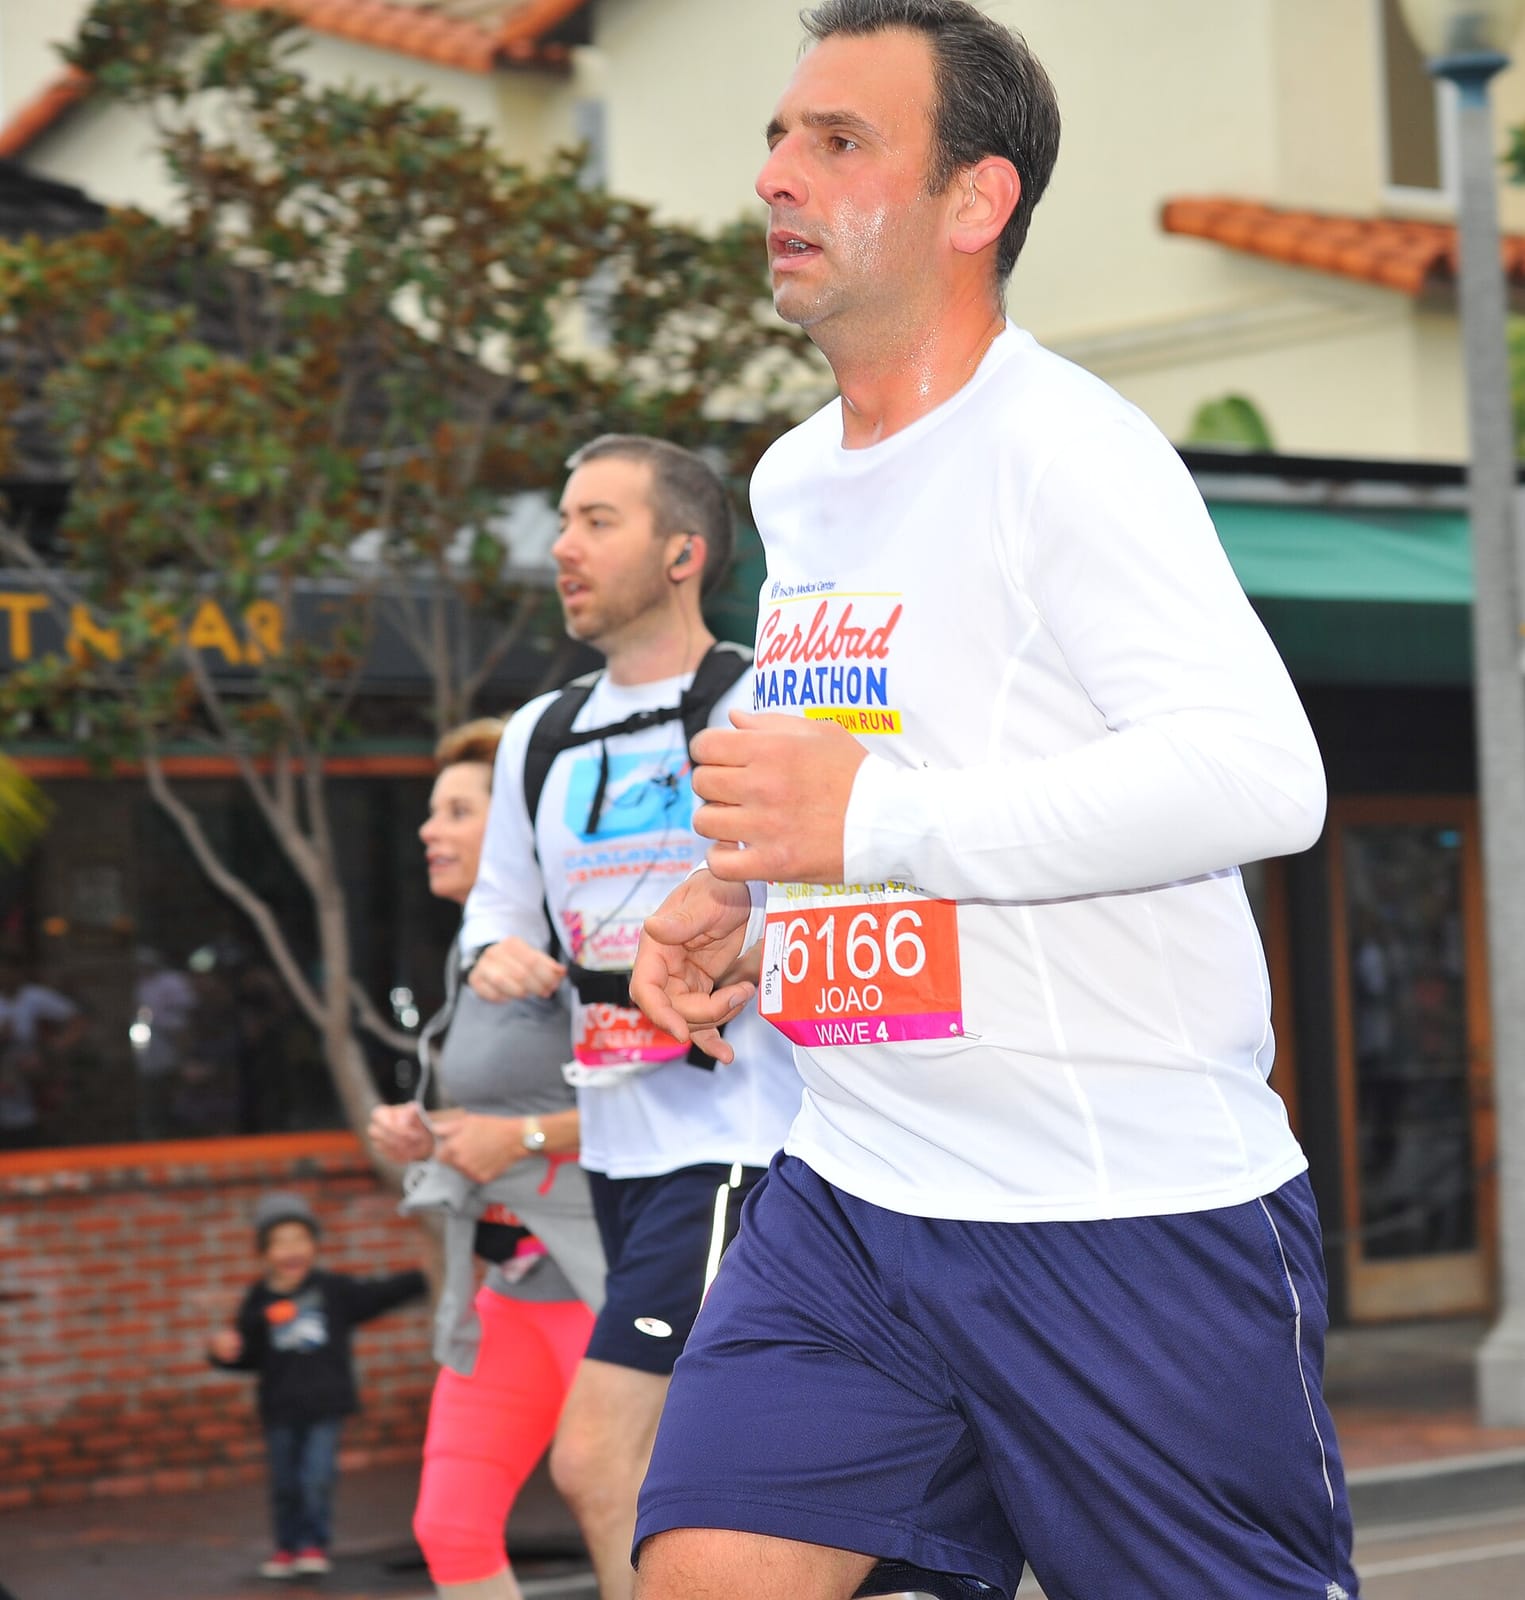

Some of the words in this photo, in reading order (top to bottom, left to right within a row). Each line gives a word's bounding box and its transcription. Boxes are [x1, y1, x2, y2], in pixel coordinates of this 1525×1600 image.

[816, 580, 836, 592] Center
[756, 600, 904, 670] Carlsbad
[755, 665, 889, 711] MARATHON
[836, 714, 857, 730] SUN
[859, 712, 895, 731] RUN
[782, 908, 927, 984] 6166
[814, 984, 883, 1014] JOAO
[815, 1021, 871, 1045] WAVE
[875, 1020, 890, 1042] 4
